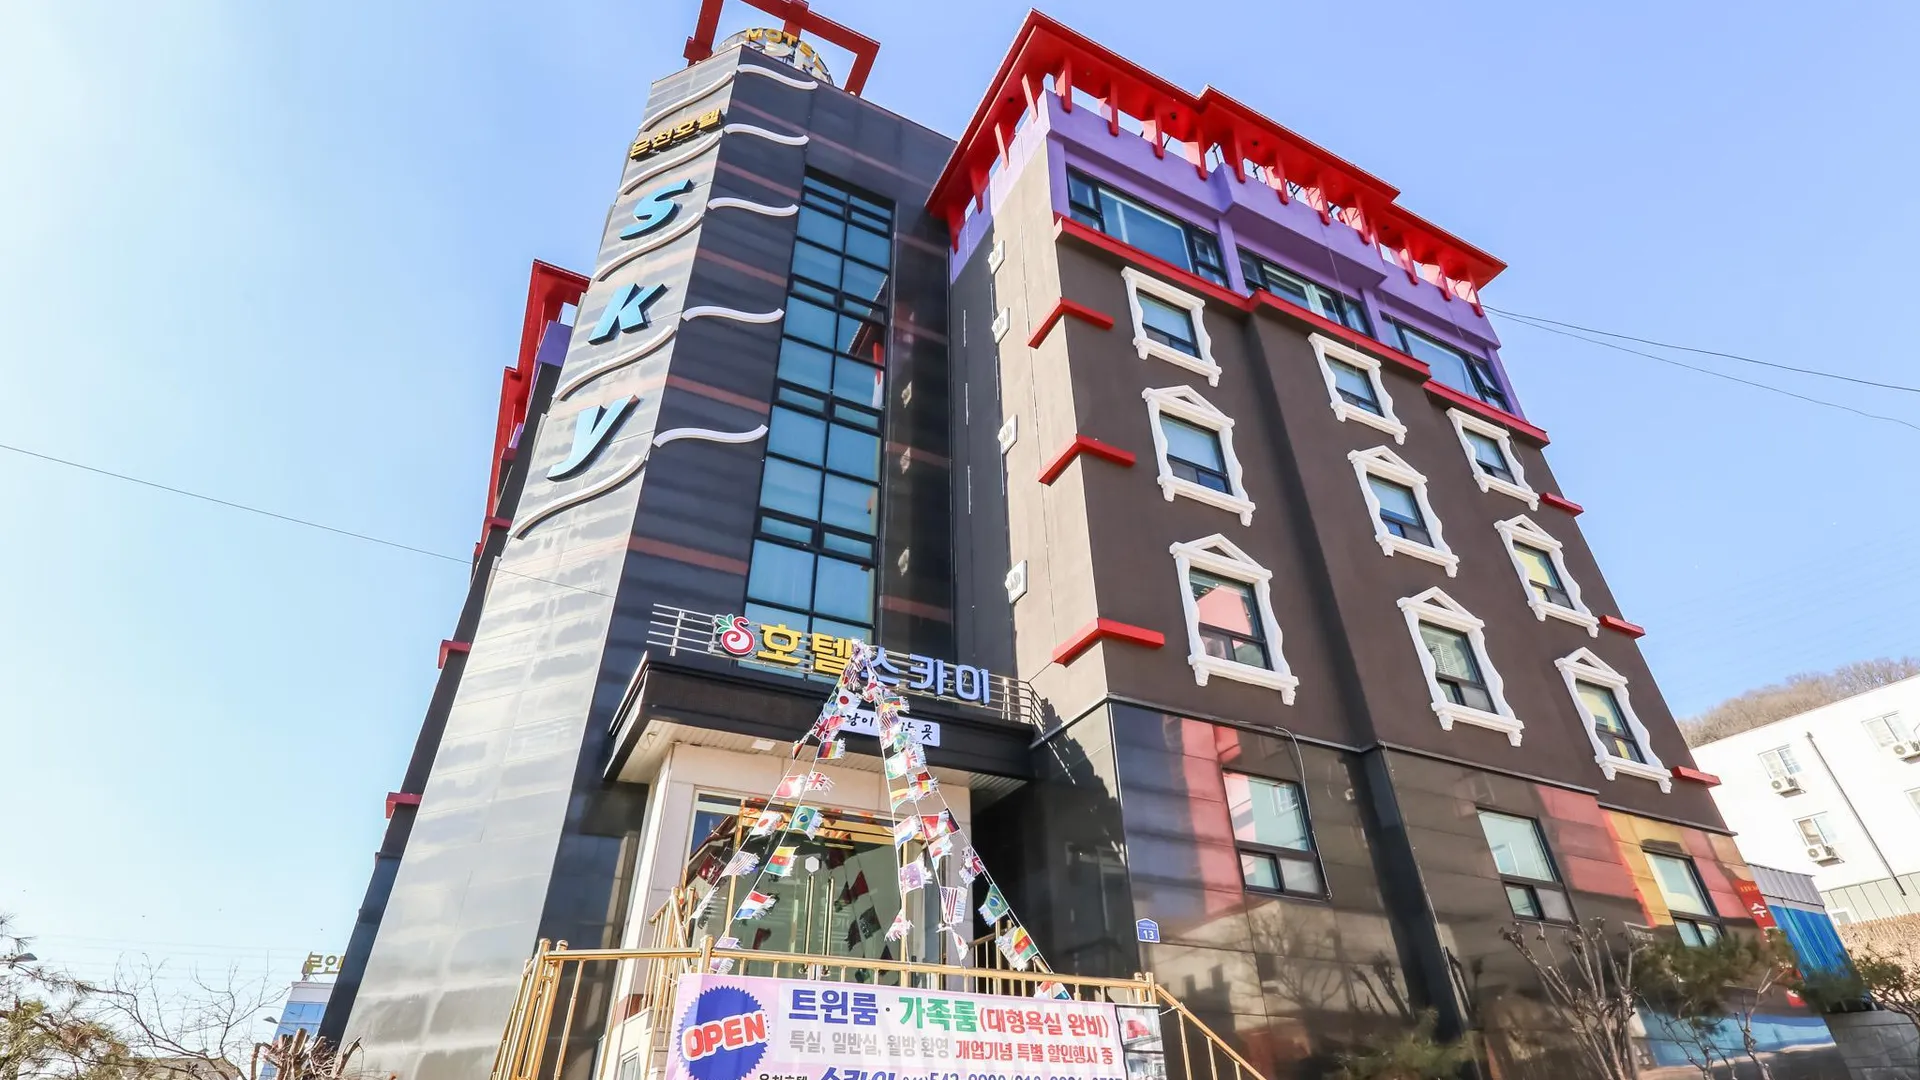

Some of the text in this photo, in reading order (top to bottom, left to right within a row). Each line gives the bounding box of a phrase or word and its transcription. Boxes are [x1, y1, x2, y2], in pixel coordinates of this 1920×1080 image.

[745, 27, 825, 73] MOTEL
[756, 623, 991, 705] 호텔 스카이
[1143, 930, 1155, 940] 13
[684, 1013, 766, 1058] OPEN
[898, 996, 977, 1033] 가족룸
[1067, 1013, 1109, 1038] 완비)
[789, 1030, 826, 1054] 특실,
[832, 1031, 882, 1056] 일반실,
[921, 1036, 949, 1059] 환영
[956, 1040, 1013, 1061] 개업기념
[1017, 1043, 1044, 1063] 특별
[1047, 1044, 1098, 1065] 할인행사
[1101, 1047, 1113, 1065] 중
